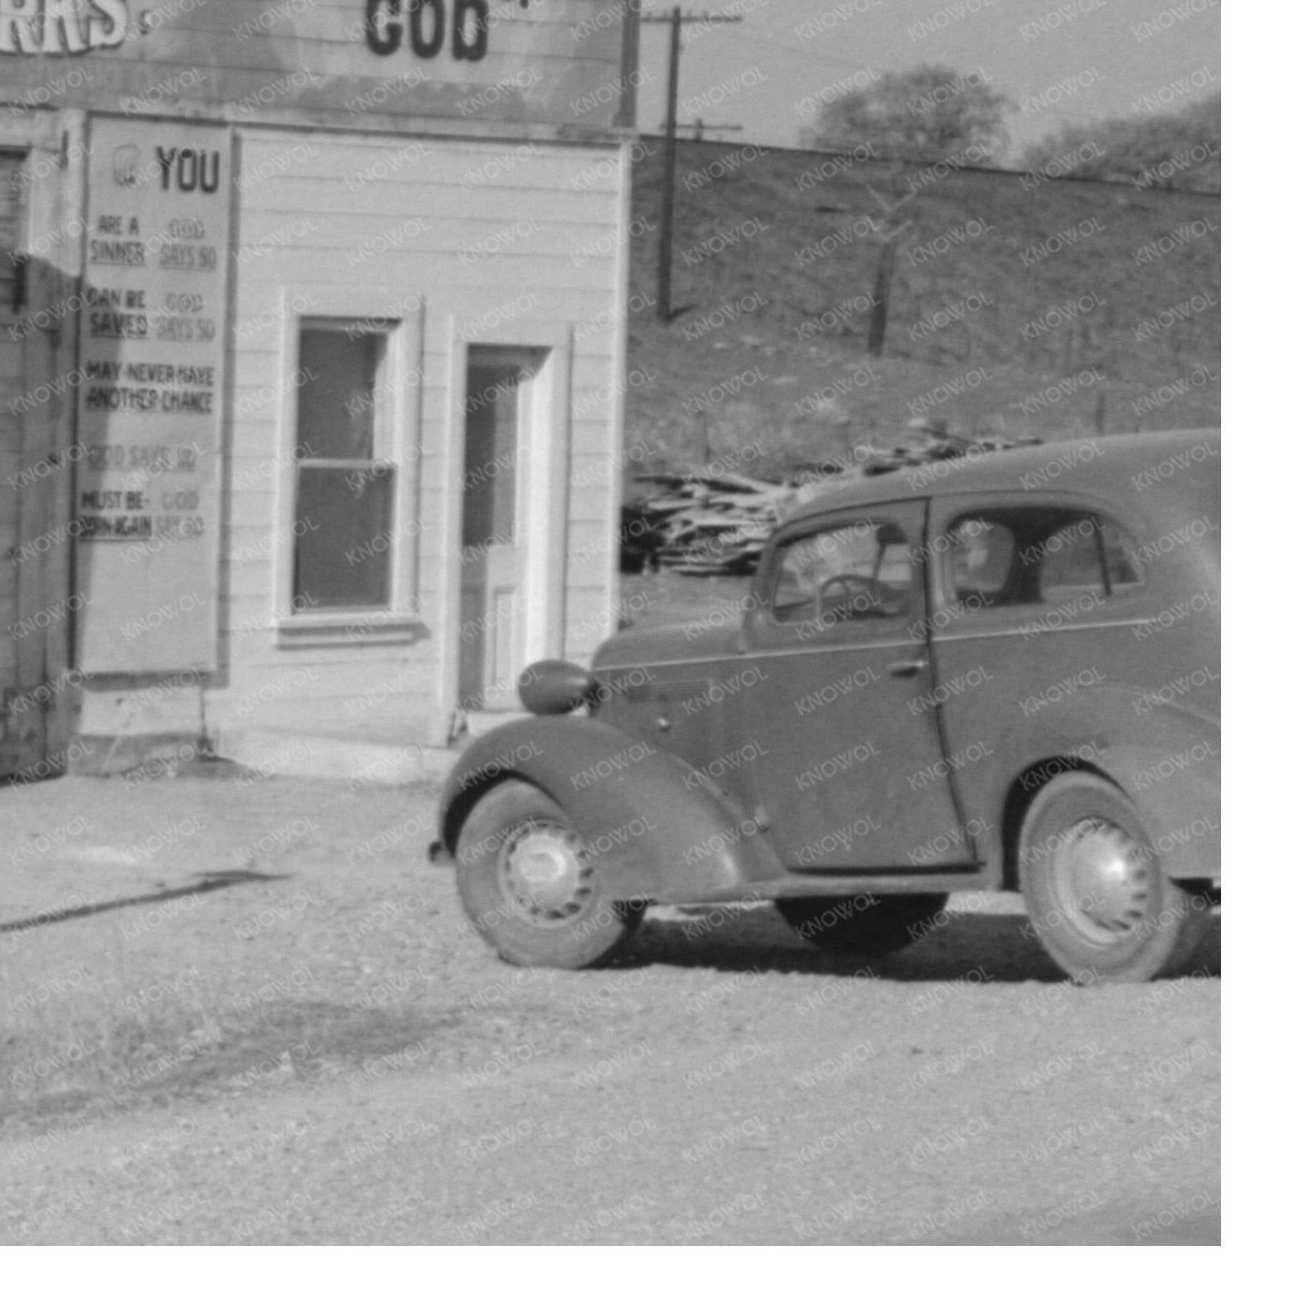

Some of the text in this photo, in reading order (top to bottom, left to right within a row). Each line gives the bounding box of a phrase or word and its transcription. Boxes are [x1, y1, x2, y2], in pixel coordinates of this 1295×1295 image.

[156, 146, 220, 194] YOU
[98, 215, 140, 235] ARE A
[90, 239, 146, 262] SINNER
[88, 288, 147, 309] CAN BE
[90, 312, 148, 336] SAVED
[86, 360, 120, 381] MAY
[127, 363, 175, 384] NEVER
[81, 491, 122, 509] MUST
